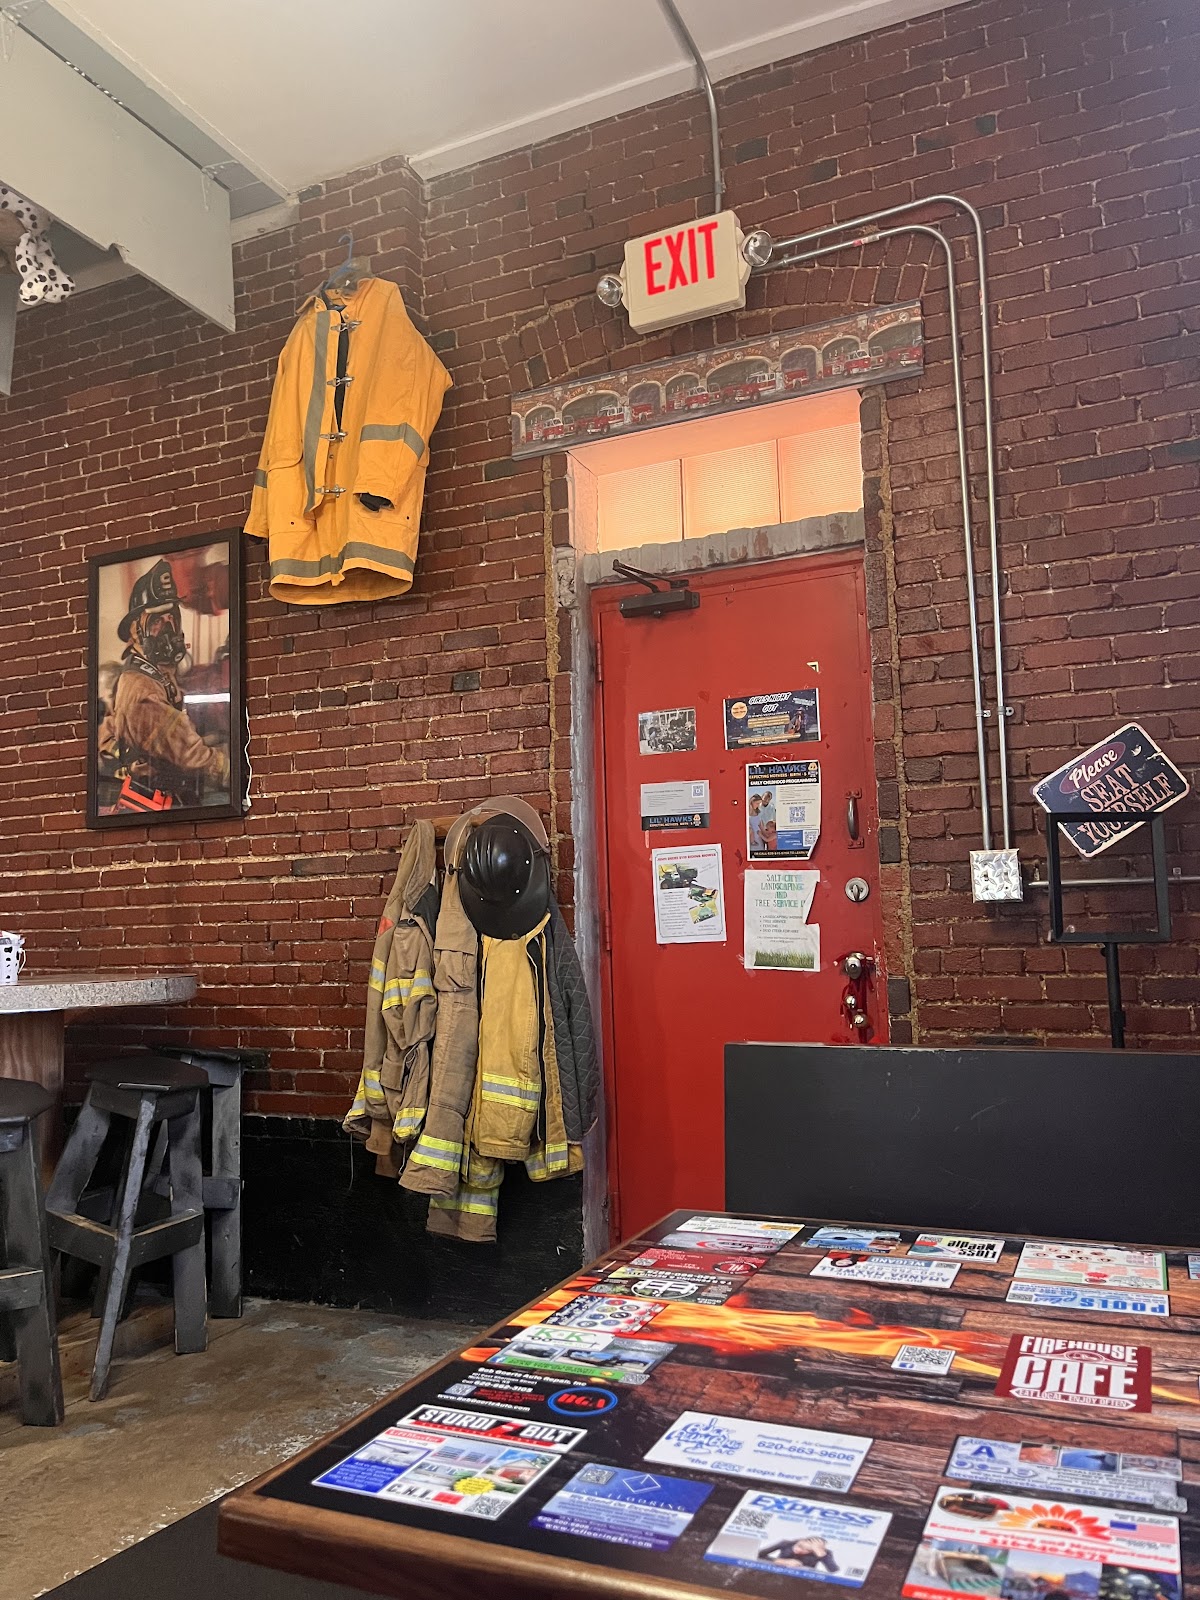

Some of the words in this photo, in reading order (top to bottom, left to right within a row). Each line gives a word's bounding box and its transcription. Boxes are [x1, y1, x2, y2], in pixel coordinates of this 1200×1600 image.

[644, 221, 718, 295] EXIT
[770, 692, 792, 702] NIGHT
[762, 703, 779, 713] OUT
[768, 764, 807, 774] HAWKS
[1069, 750, 1117, 788] Please
[1081, 763, 1140, 812] SEAT
[761, 882, 804, 890] LANDSCAPING
[773, 899, 798, 907] SERVICE
[871, 1256, 927, 1267] WEIGAND
[820, 1265, 885, 1278] MAXWELL
[891, 1273, 949, 1282] AMANDA
[1080, 1298, 1165, 1313] POOLS
[535, 1328, 556, 1339] K
[565, 1332, 588, 1342] K
[1020, 1336, 1138, 1363] FIREHOUSE
[1011, 1356, 1138, 1400] CAFE
[1019, 1389, 1036, 1397] EAT
[1068, 1396, 1098, 1404] ENJOY
[1100, 1399, 1127, 1407] OFTEN
[419, 1409, 498, 1430] STURDI
[519, 1425, 572, 1441] BILT
[757, 1441, 856, 1462] 620-663-9606
[971, 1446, 995, 1458] A
[747, 1467, 775, 1478] stops
[751, 1495, 876, 1525] Express
[930, 1522, 976, 1534] Kansas
[980, 1530, 1038, 1542] Services
[1041, 1538, 1066, 1546] and
[1070, 1542, 1177, 1564] Manufacturing
